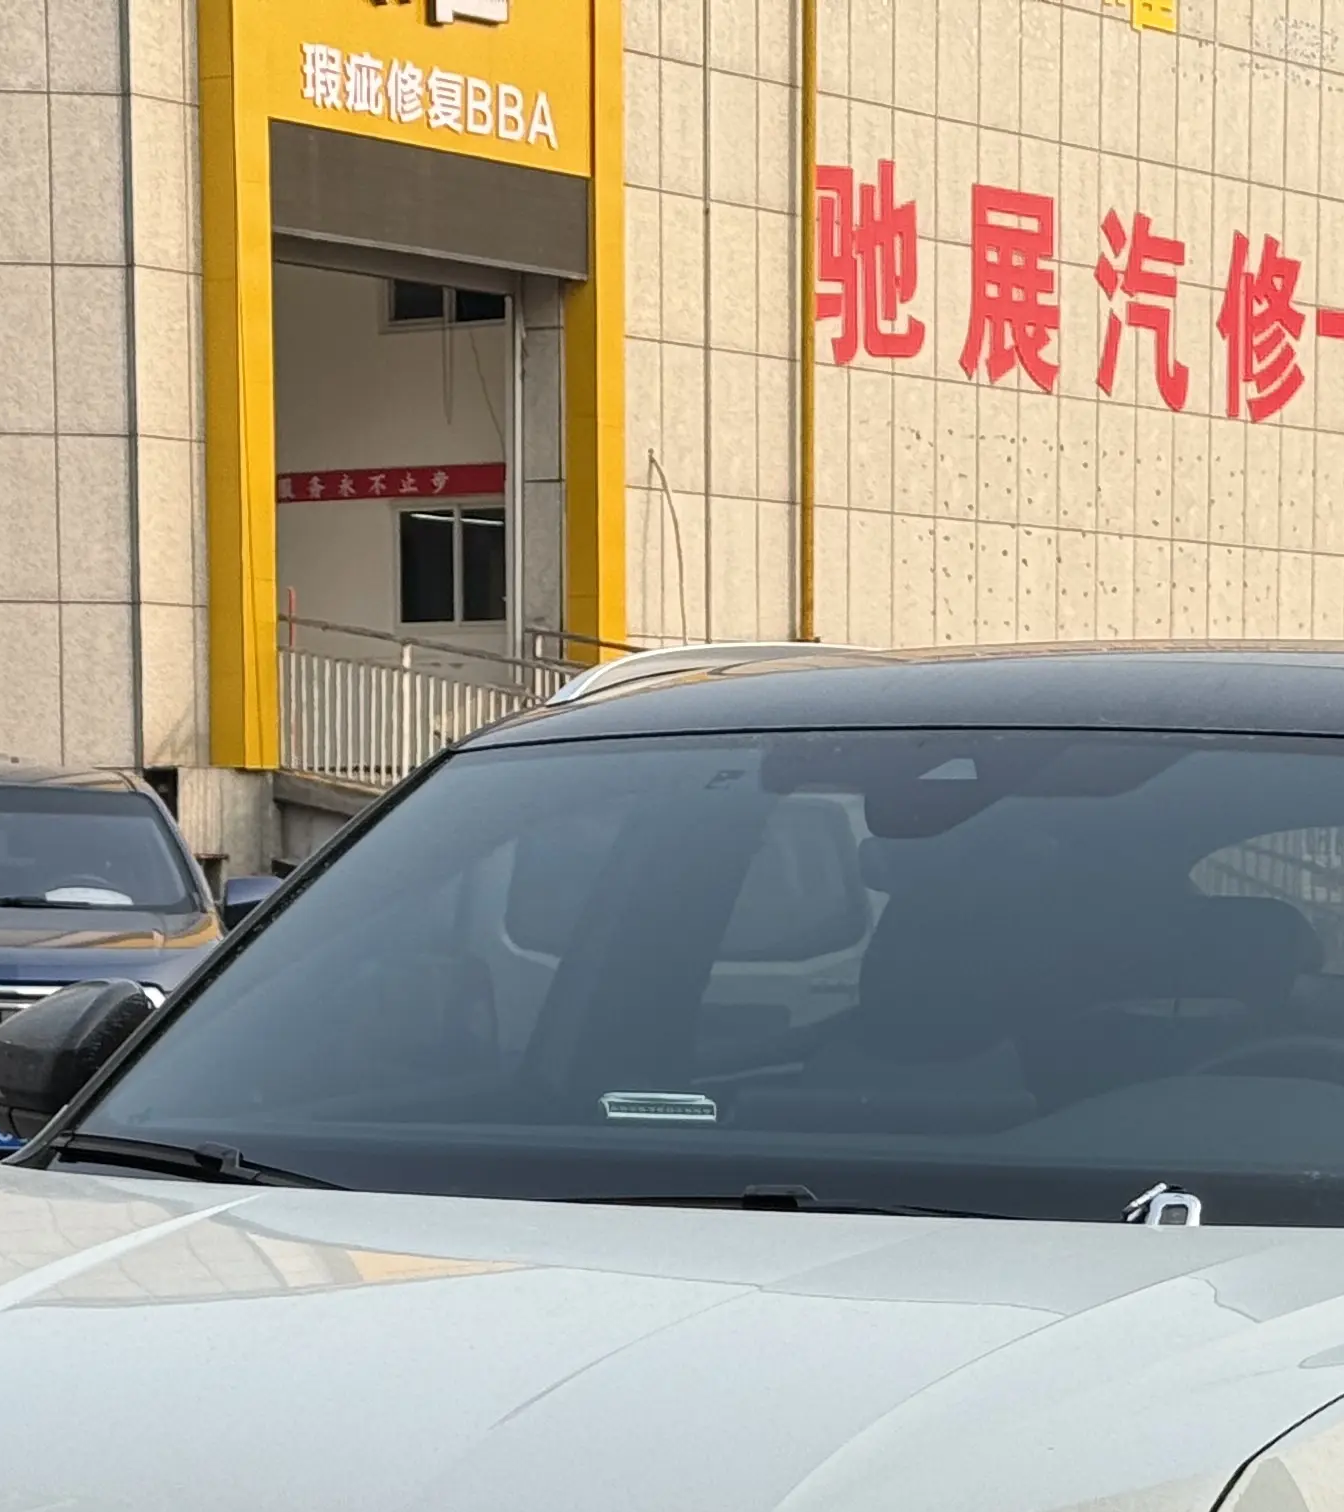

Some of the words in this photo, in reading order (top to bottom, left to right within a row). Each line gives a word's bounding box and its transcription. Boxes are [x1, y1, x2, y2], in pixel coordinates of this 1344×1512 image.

[301, 40, 559, 150] 瑕疵修复BBA
[814, 158, 1306, 423] 驰展汽修
